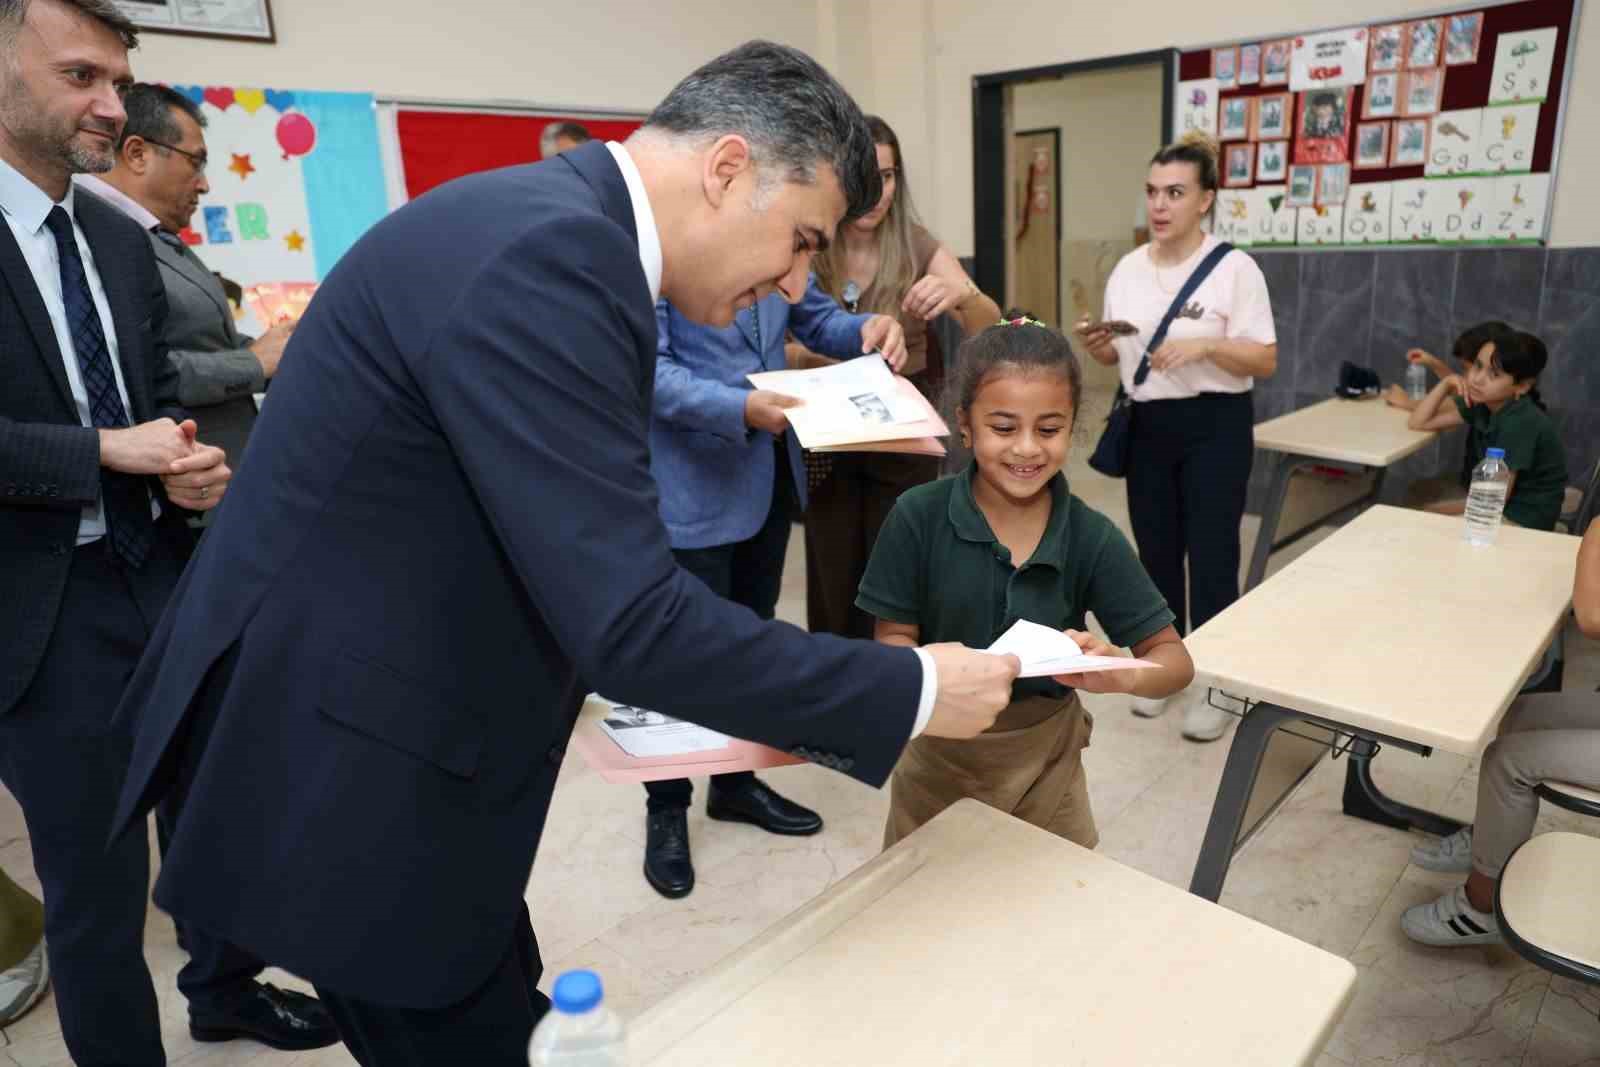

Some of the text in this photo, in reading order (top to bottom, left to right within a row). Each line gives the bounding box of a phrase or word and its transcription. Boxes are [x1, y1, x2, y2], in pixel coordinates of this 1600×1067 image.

[1446, 212, 1482, 232] D d
[1498, 210, 1513, 231] Z
